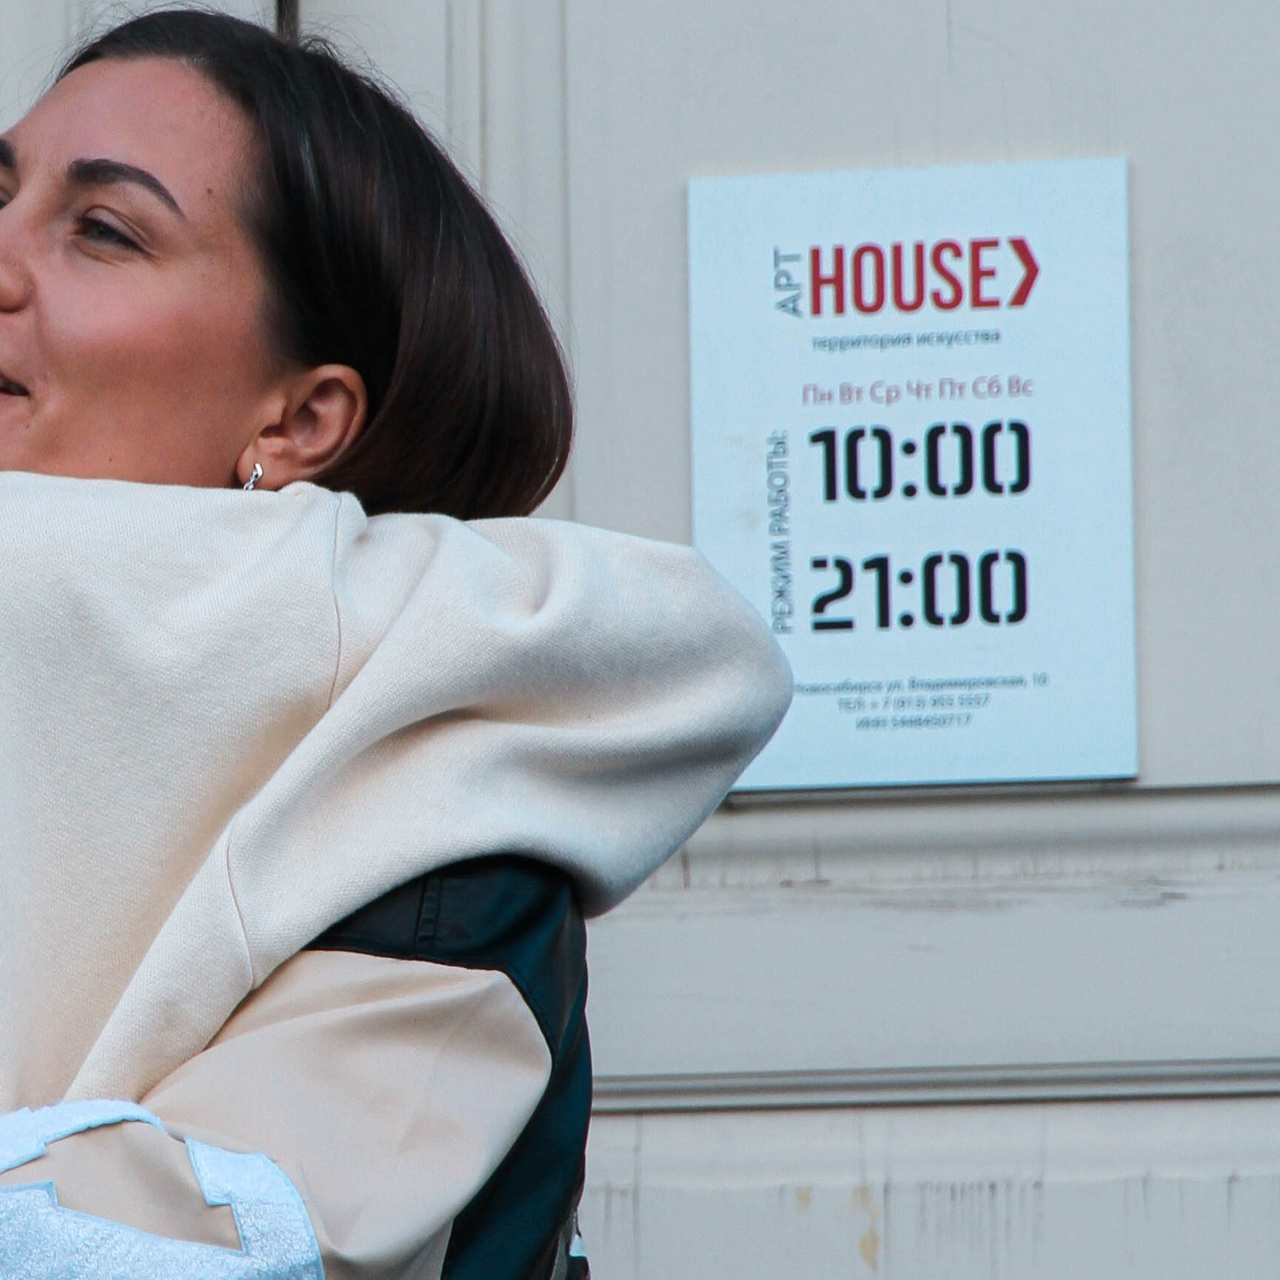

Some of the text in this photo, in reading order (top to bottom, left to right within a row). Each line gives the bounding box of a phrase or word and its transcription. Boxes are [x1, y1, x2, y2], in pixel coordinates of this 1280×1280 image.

[773, 246, 804, 318] АРТ
[810, 237, 1001, 316] HOUSE
[812, 327, 1001, 353] территория искусства
[802, 373, 1035, 406] Пн Вт Ср Чт Пт Сб Вс
[808, 420, 1032, 502] 10:00
[771, 540, 793, 634] РЕЖИМ
[810, 548, 1028, 631] 21:00
